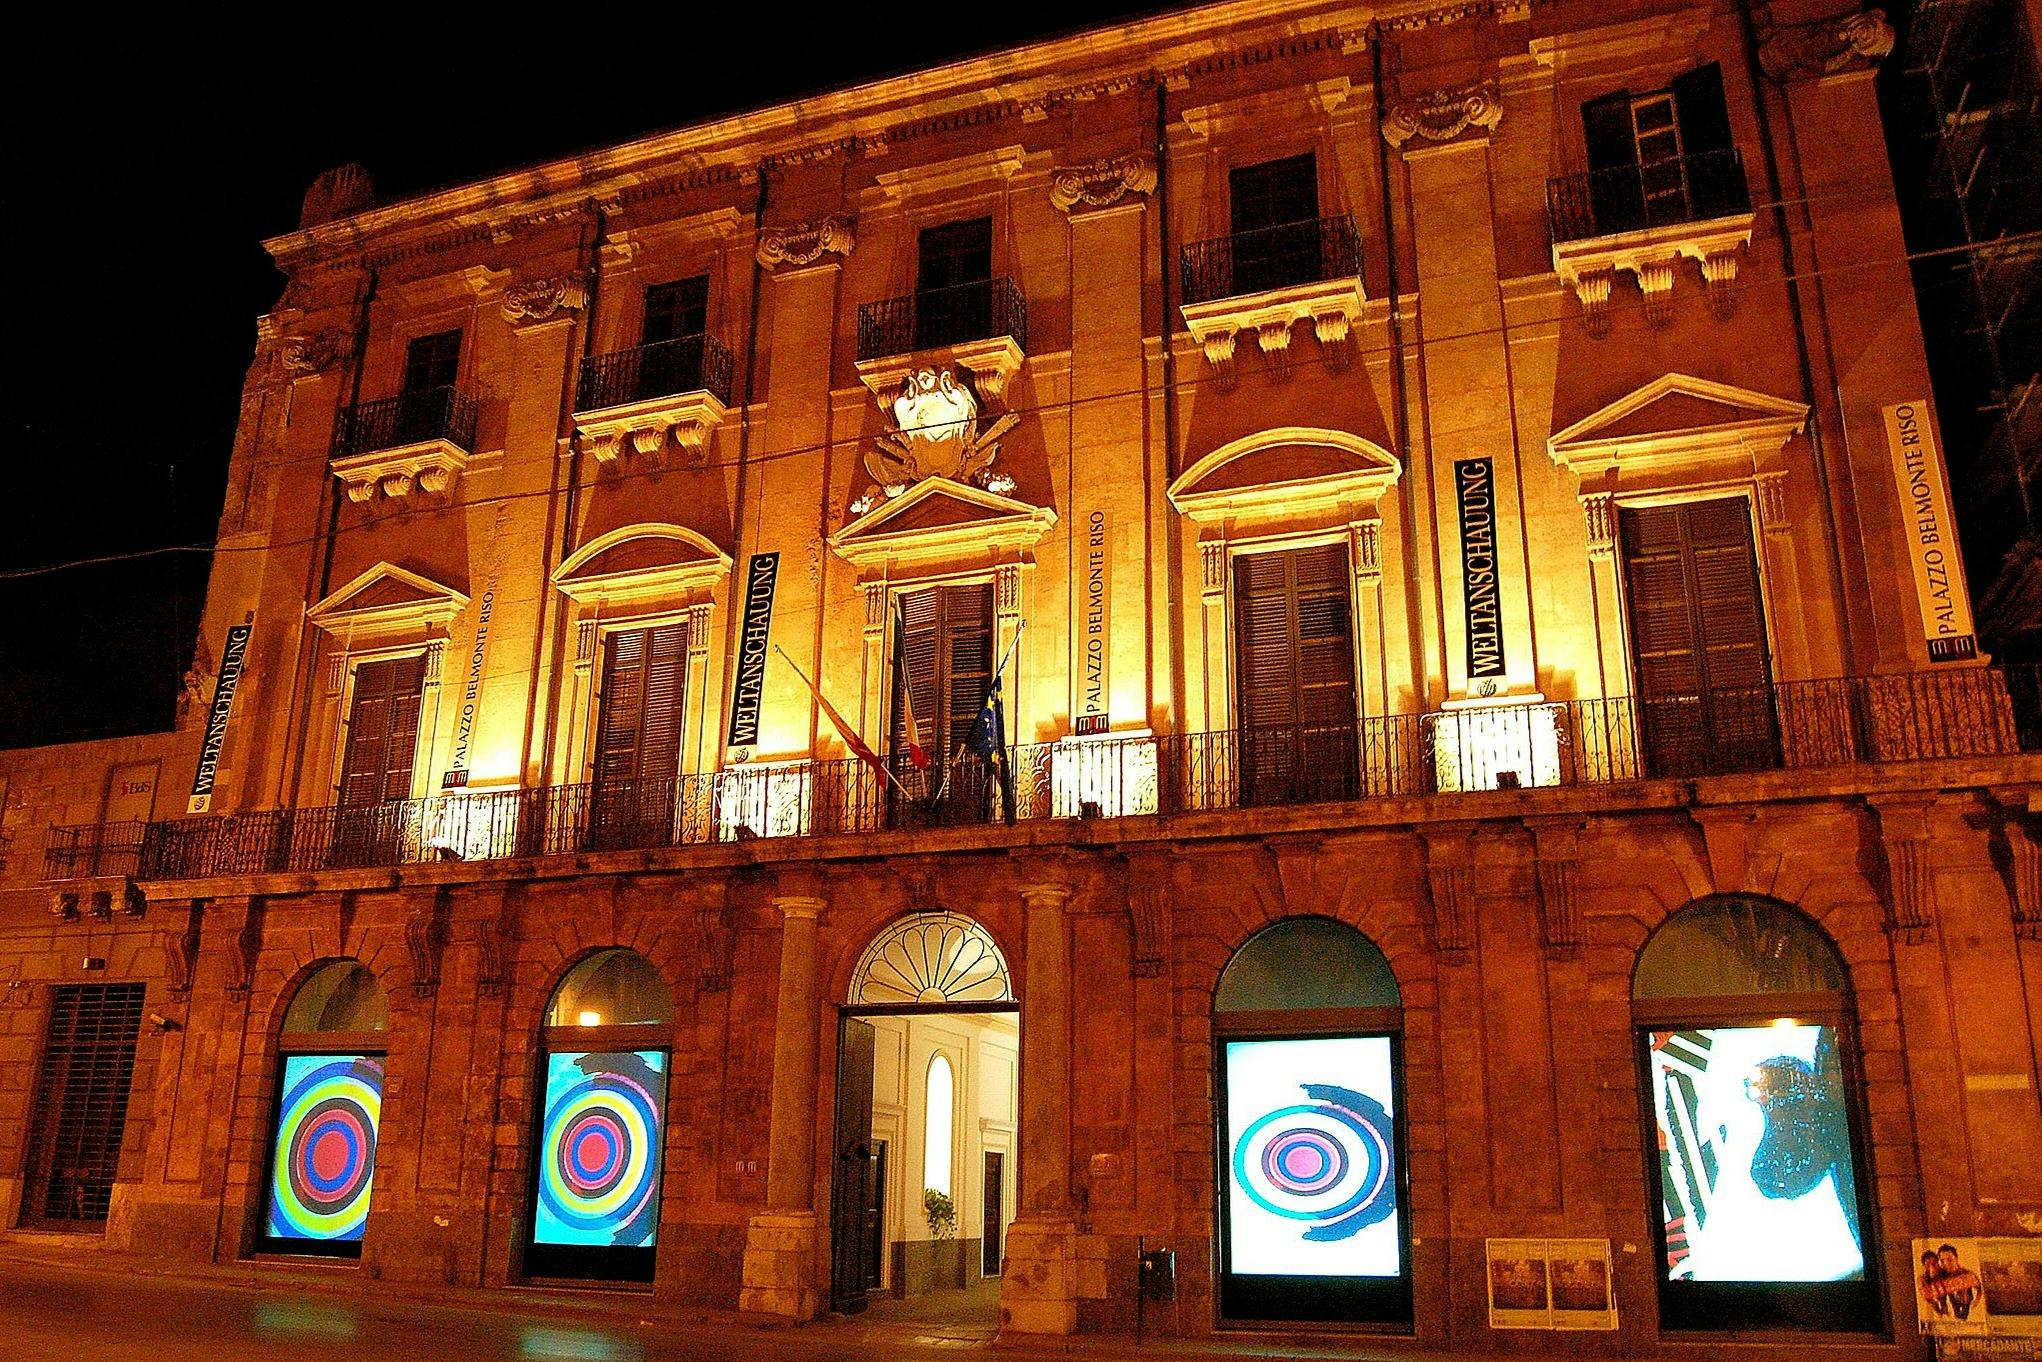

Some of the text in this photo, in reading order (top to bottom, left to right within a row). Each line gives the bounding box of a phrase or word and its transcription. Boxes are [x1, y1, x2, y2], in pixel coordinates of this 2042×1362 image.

[1086, 511, 1105, 713] PALAZZO BELMONTE RISO
[1461, 461, 1501, 676] WELTANSCHAUUNG
[1896, 403, 1957, 635] PALAZZO BELMONTE RISO
[195, 628, 248, 793] WELTANSCHAUUNG
[453, 591, 495, 769] PALAZZO BELMONTE RISO
[733, 556, 775, 745] WELTANSCHAUUNG
